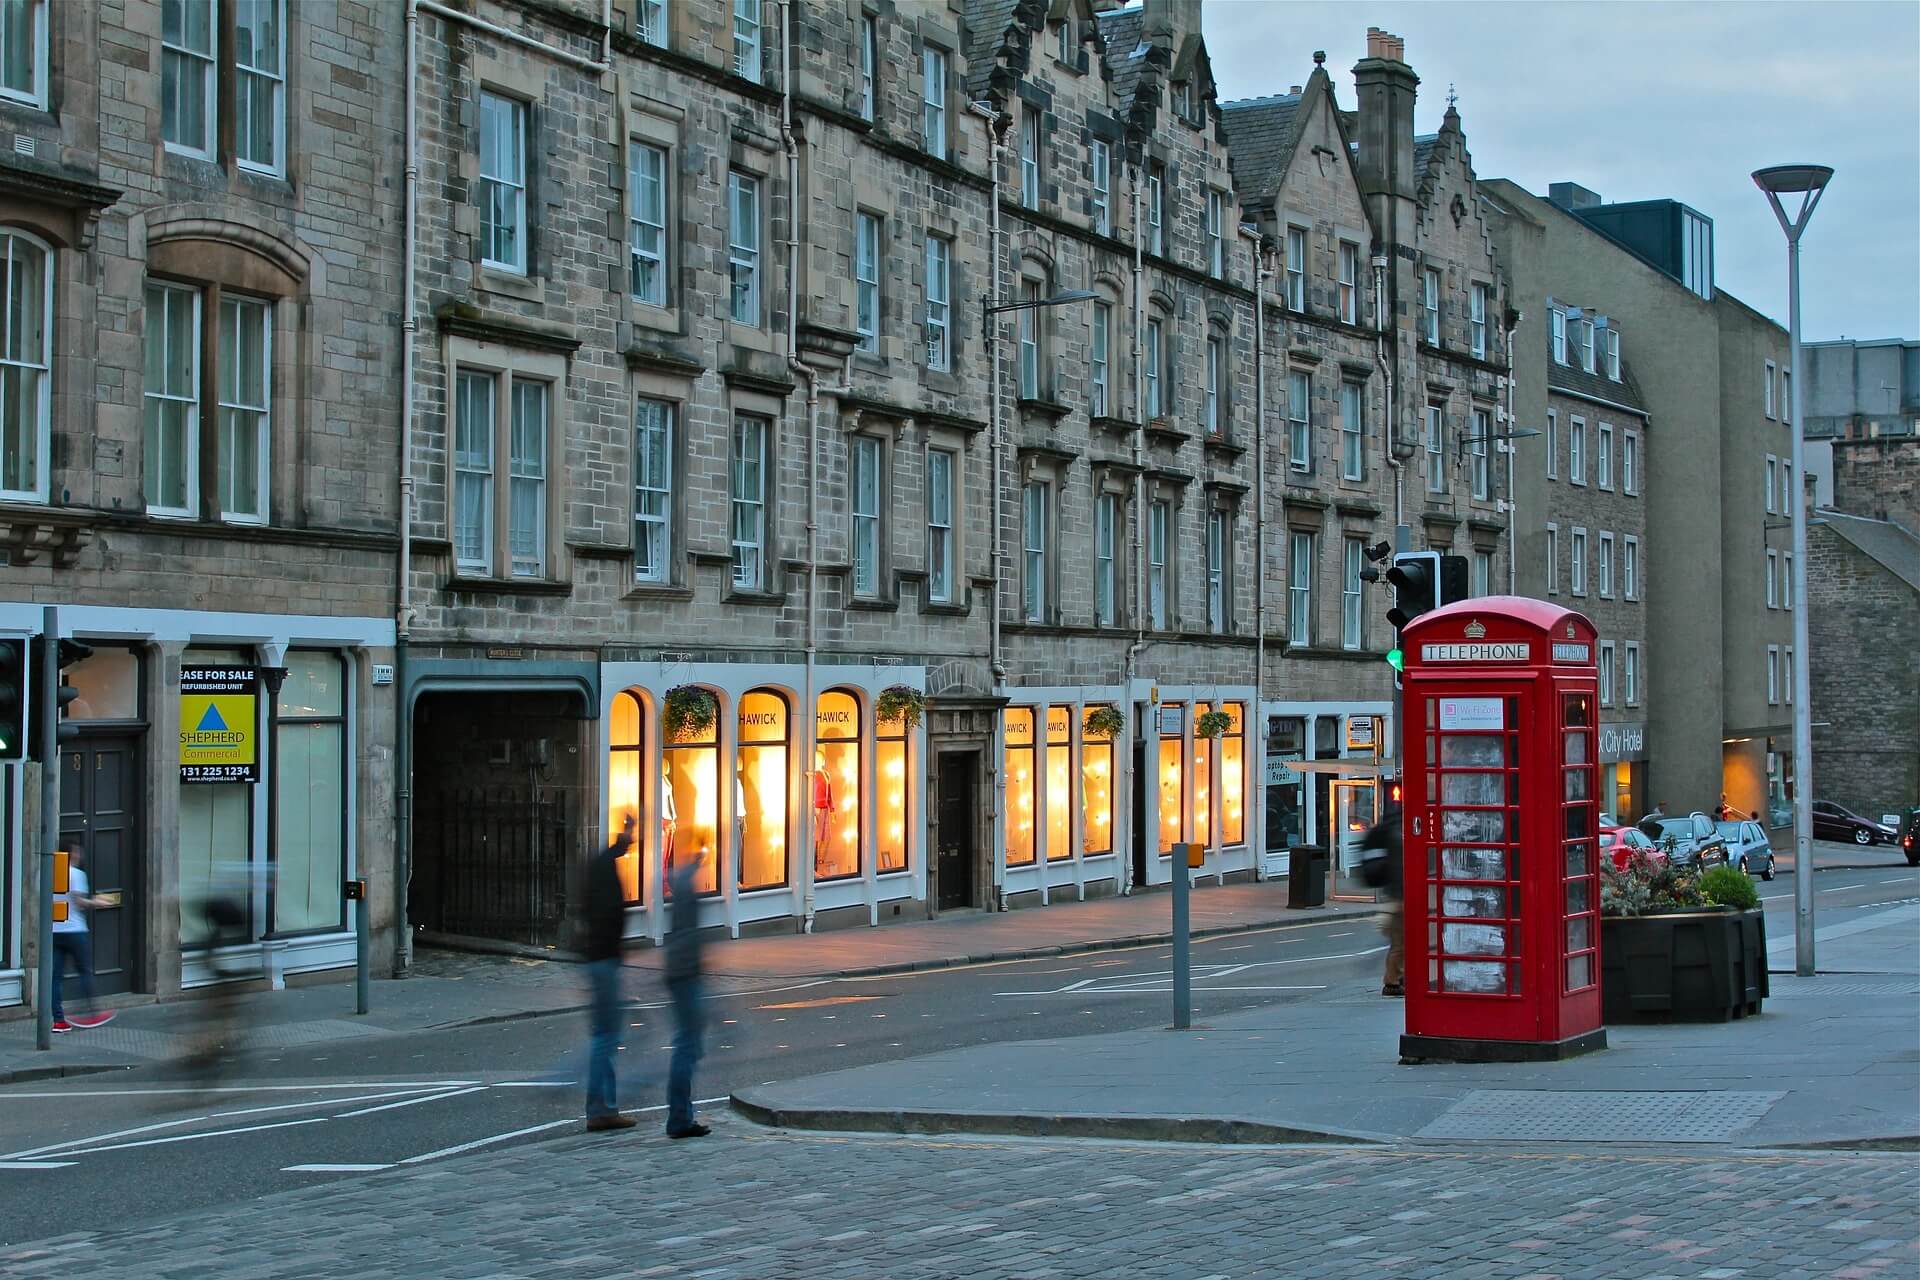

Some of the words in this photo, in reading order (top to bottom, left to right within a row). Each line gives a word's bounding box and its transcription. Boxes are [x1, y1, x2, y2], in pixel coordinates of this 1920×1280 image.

[1427, 644, 1525, 660] TELEPHONE
[1553, 645, 1587, 660] TELEPHONE
[180, 671, 203, 680] EASE
[205, 671, 226, 680] FOR
[228, 671, 254, 680] SALE
[739, 713, 777, 725] HAWICK
[817, 711, 850, 723] HAWICK
[180, 732, 245, 743] SHEPHERD
[1605, 730, 1621, 759] City
[1622, 729, 1643, 752] Hotel
[184, 749, 241, 758] Commercial
[180, 767, 200, 776] 131
[202, 767, 222, 776] 225
[224, 766, 250, 776] 1234
[1272, 771, 1290, 781] Repair
